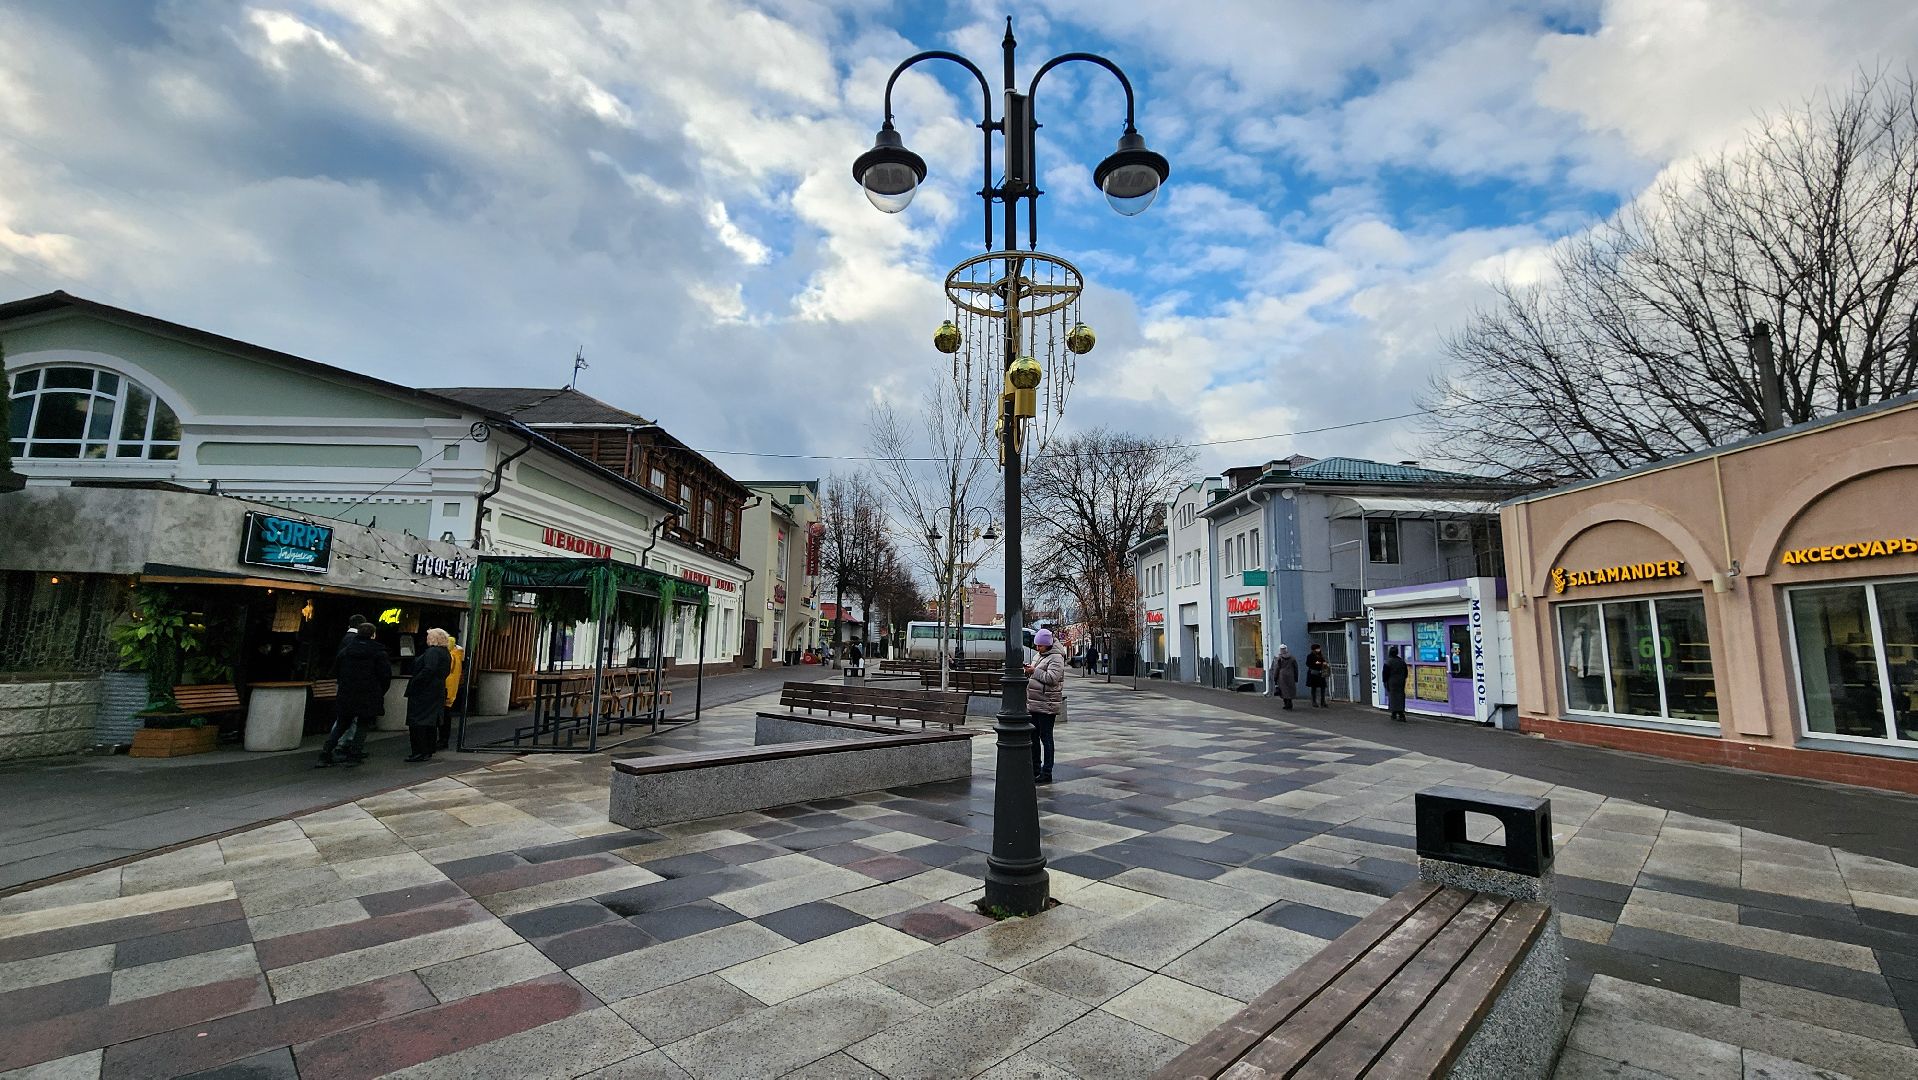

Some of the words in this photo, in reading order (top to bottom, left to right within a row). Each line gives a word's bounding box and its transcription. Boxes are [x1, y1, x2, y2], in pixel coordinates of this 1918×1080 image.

[262, 517, 329, 550] SORRY
[543, 527, 612, 559] ЦЕНОПАД
[1566, 560, 1682, 587] SALAMANDER
